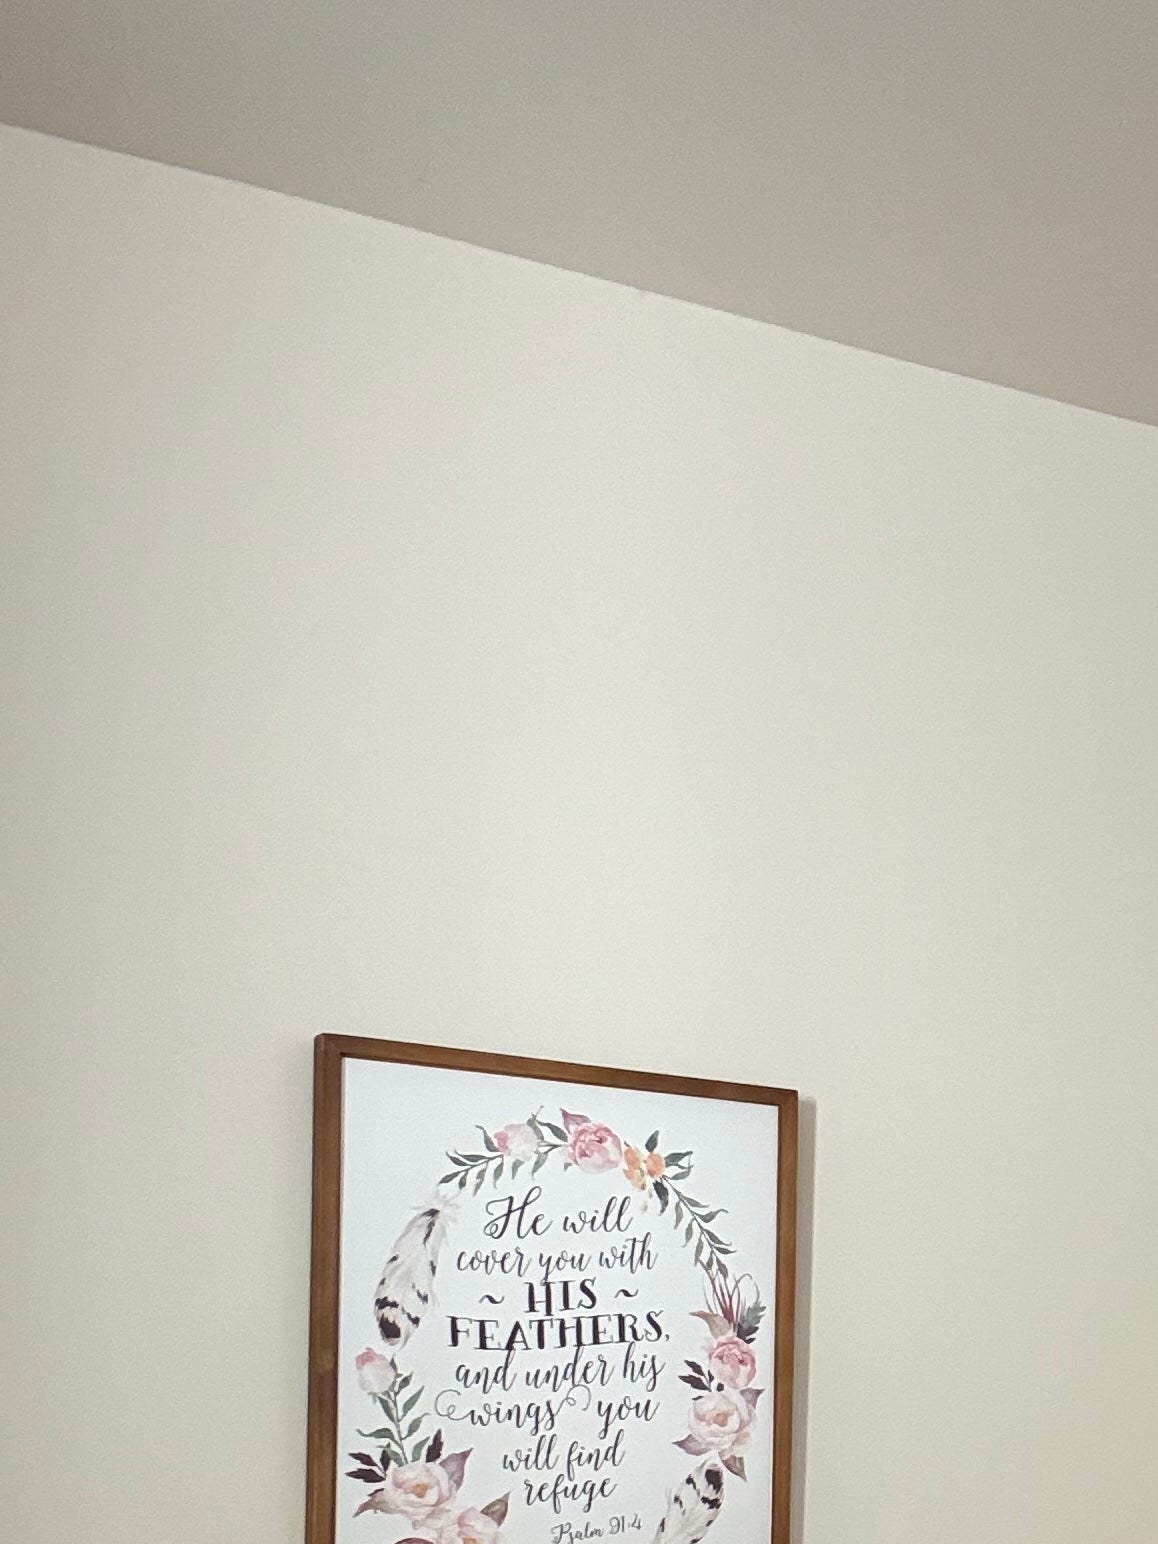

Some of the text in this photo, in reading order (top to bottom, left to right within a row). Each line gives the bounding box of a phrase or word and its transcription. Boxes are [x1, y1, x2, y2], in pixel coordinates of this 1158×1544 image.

[483, 1186, 634, 1239] He will
[457, 1232, 659, 1286] cover you with
[524, 1277, 598, 1316] HIS
[446, 1310, 670, 1350] FEATHERS,
[455, 1341, 666, 1394] and under his
[434, 1384, 660, 1440] wings you
[503, 1429, 626, 1481] will find
[524, 1474, 618, 1514] refuge
